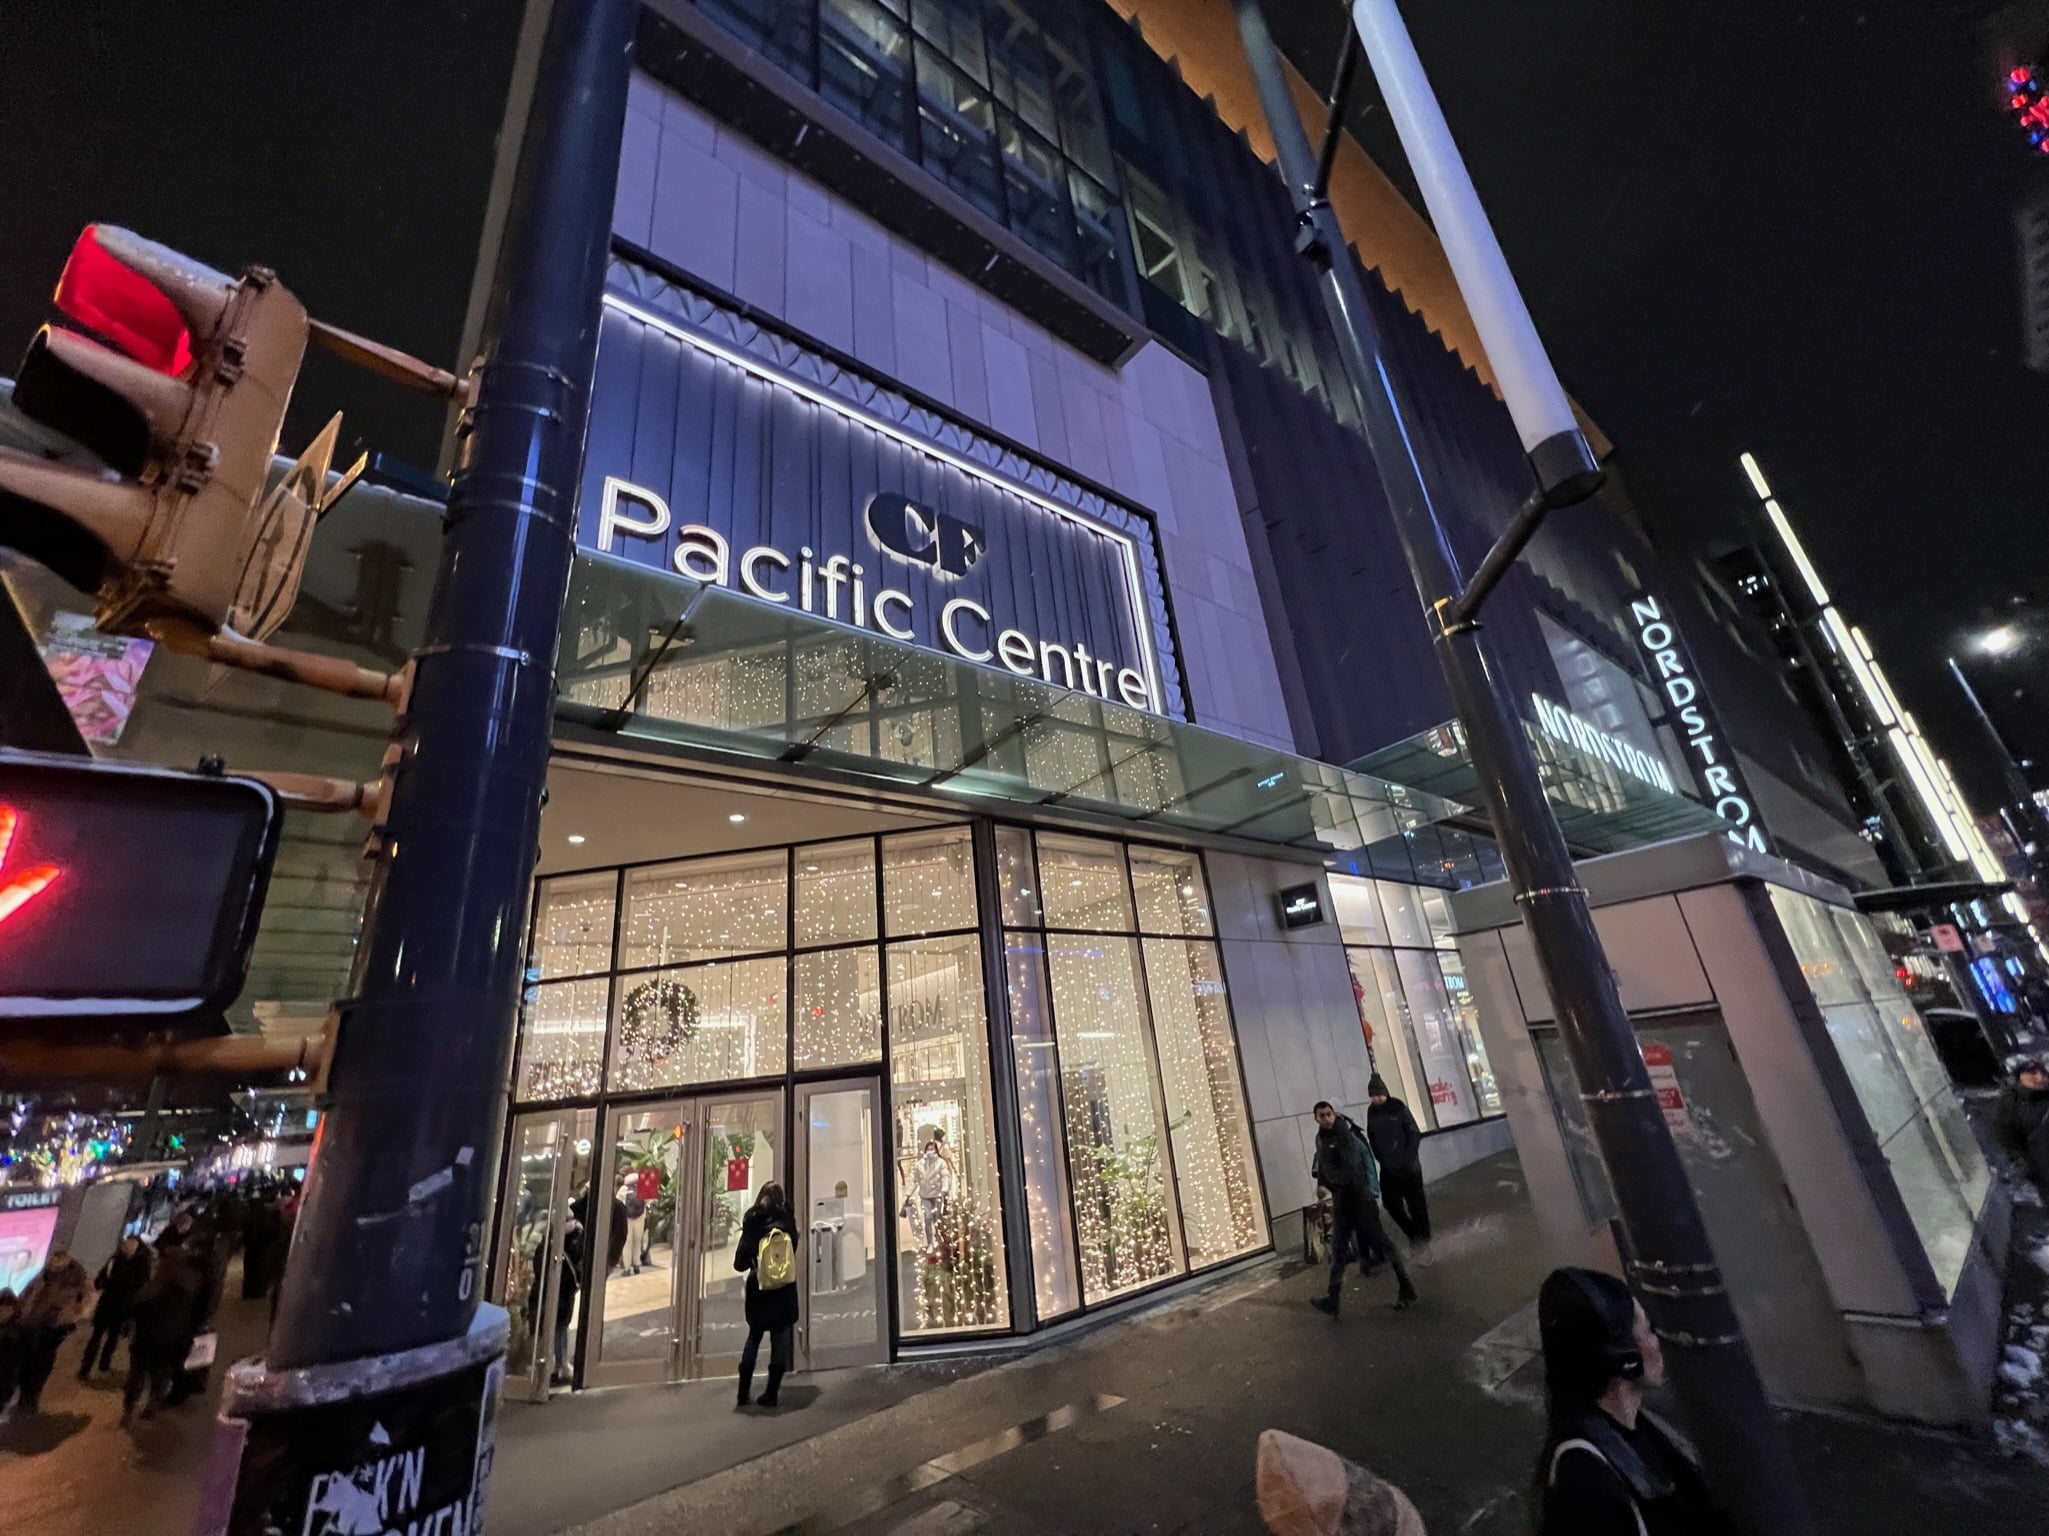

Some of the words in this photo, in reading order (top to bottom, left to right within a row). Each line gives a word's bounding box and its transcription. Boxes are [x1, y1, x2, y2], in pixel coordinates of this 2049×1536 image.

[596, 476, 915, 640] Pacific
[941, 597, 1150, 709] Centre
[1531, 692, 1675, 795] NORDSTROM
[1631, 595, 1768, 854] NORDSTROM
[302, 1445, 426, 1536] FK'N
